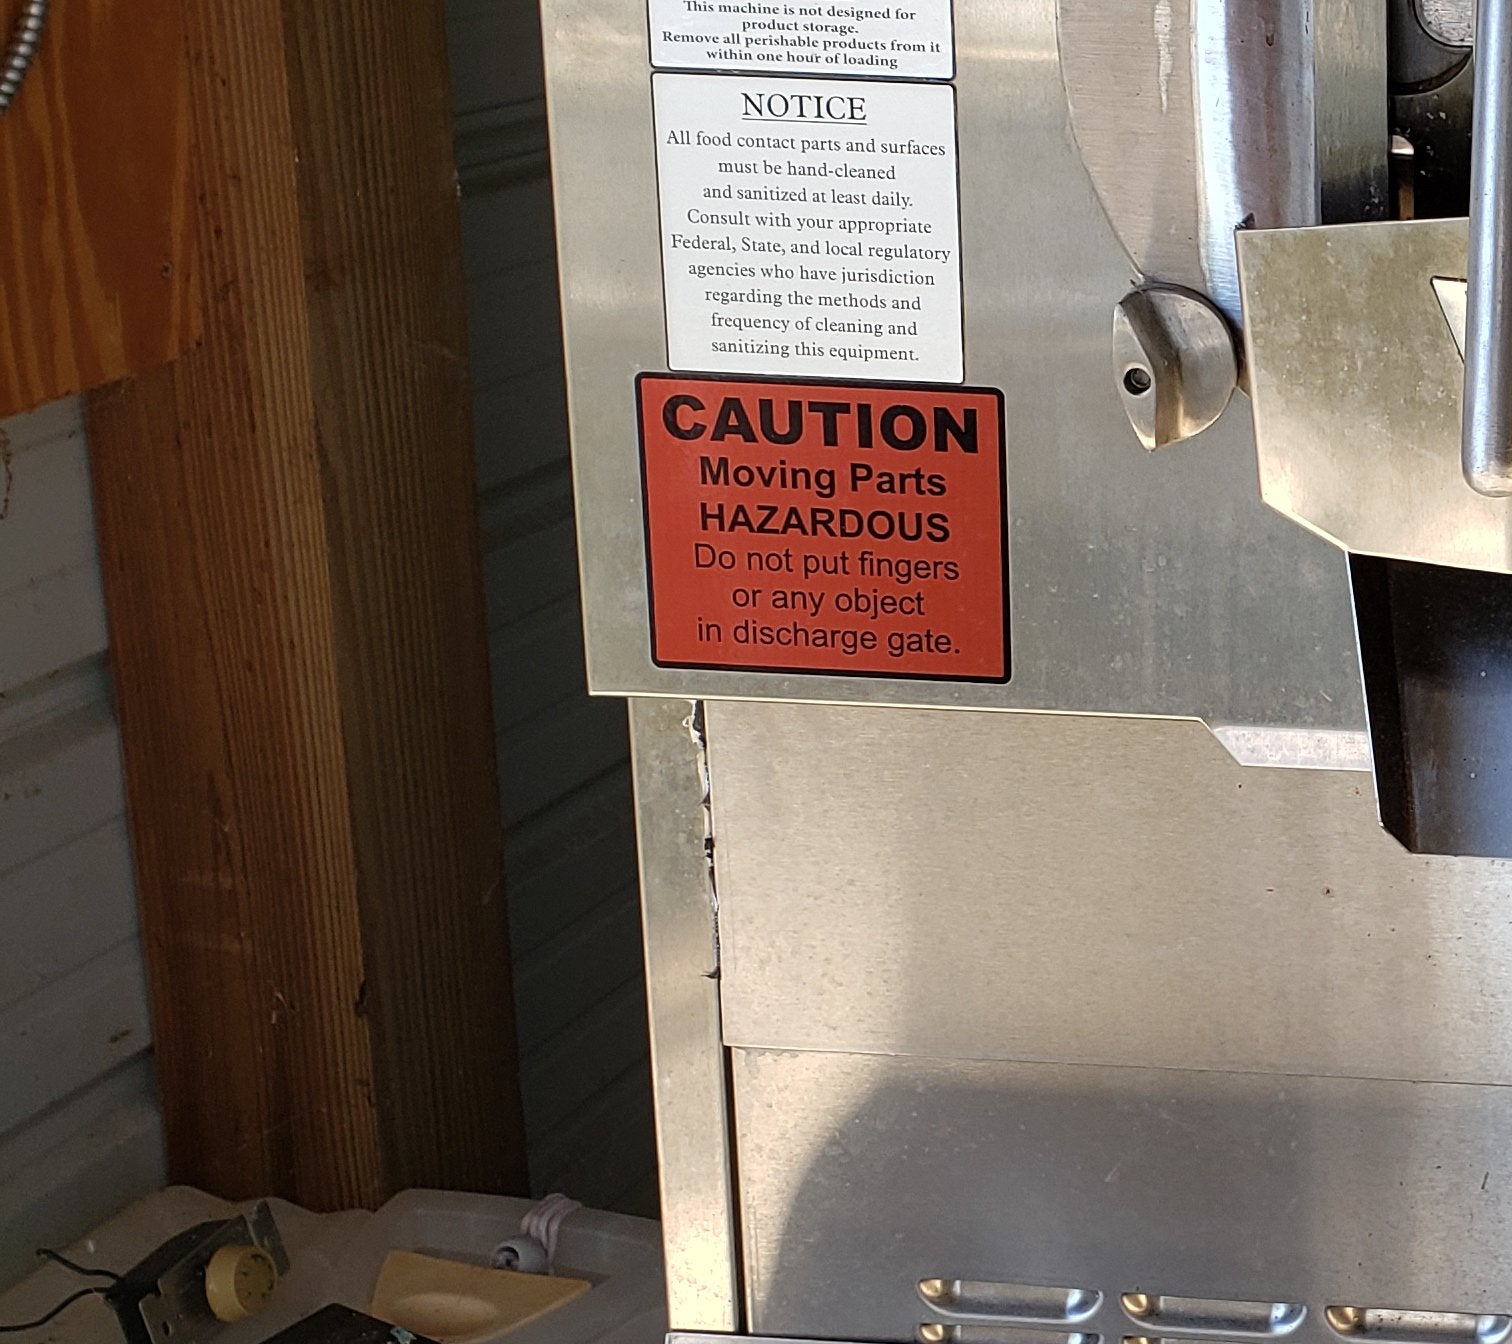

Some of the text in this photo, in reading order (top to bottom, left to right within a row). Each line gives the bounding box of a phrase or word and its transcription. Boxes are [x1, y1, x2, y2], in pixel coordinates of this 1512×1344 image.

[683, 1, 916, 21] This machine is not designed for
[743, 19, 858, 36] product storage.
[663, 31, 940, 52] Remove all perishable products from it
[707, 49, 752, 60] within
[787, 51, 821, 63] hour
[825, 53, 840, 63] of
[844, 54, 897, 69] loading
[741, 92, 867, 120] NOTICE
[667, 130, 945, 155] All food contact parts and surfaces
[719, 160, 895, 179] must be hand-cleaned
[704, 185, 912, 210] and sanitized at least daily.
[688, 209, 931, 235] Consult with your appropriate
[672, 234, 950, 263] Federal, State, and local regulatory
[689, 263, 935, 285] agencies who have jurisdiction
[705, 289, 921, 310] regarding the methods and
[712, 313, 917, 337] frequency of cleaning and
[712, 339, 918, 362] sanitizing this equipment.
[662, 393, 978, 454] CAUTION
[700, 456, 947, 498] Moving Parts
[700, 502, 950, 542] HAZARDOUS
[694, 543, 960, 584] Do not put fingers
[732, 588, 925, 619] or any object
[697, 618, 961, 656] in discharge gate.
